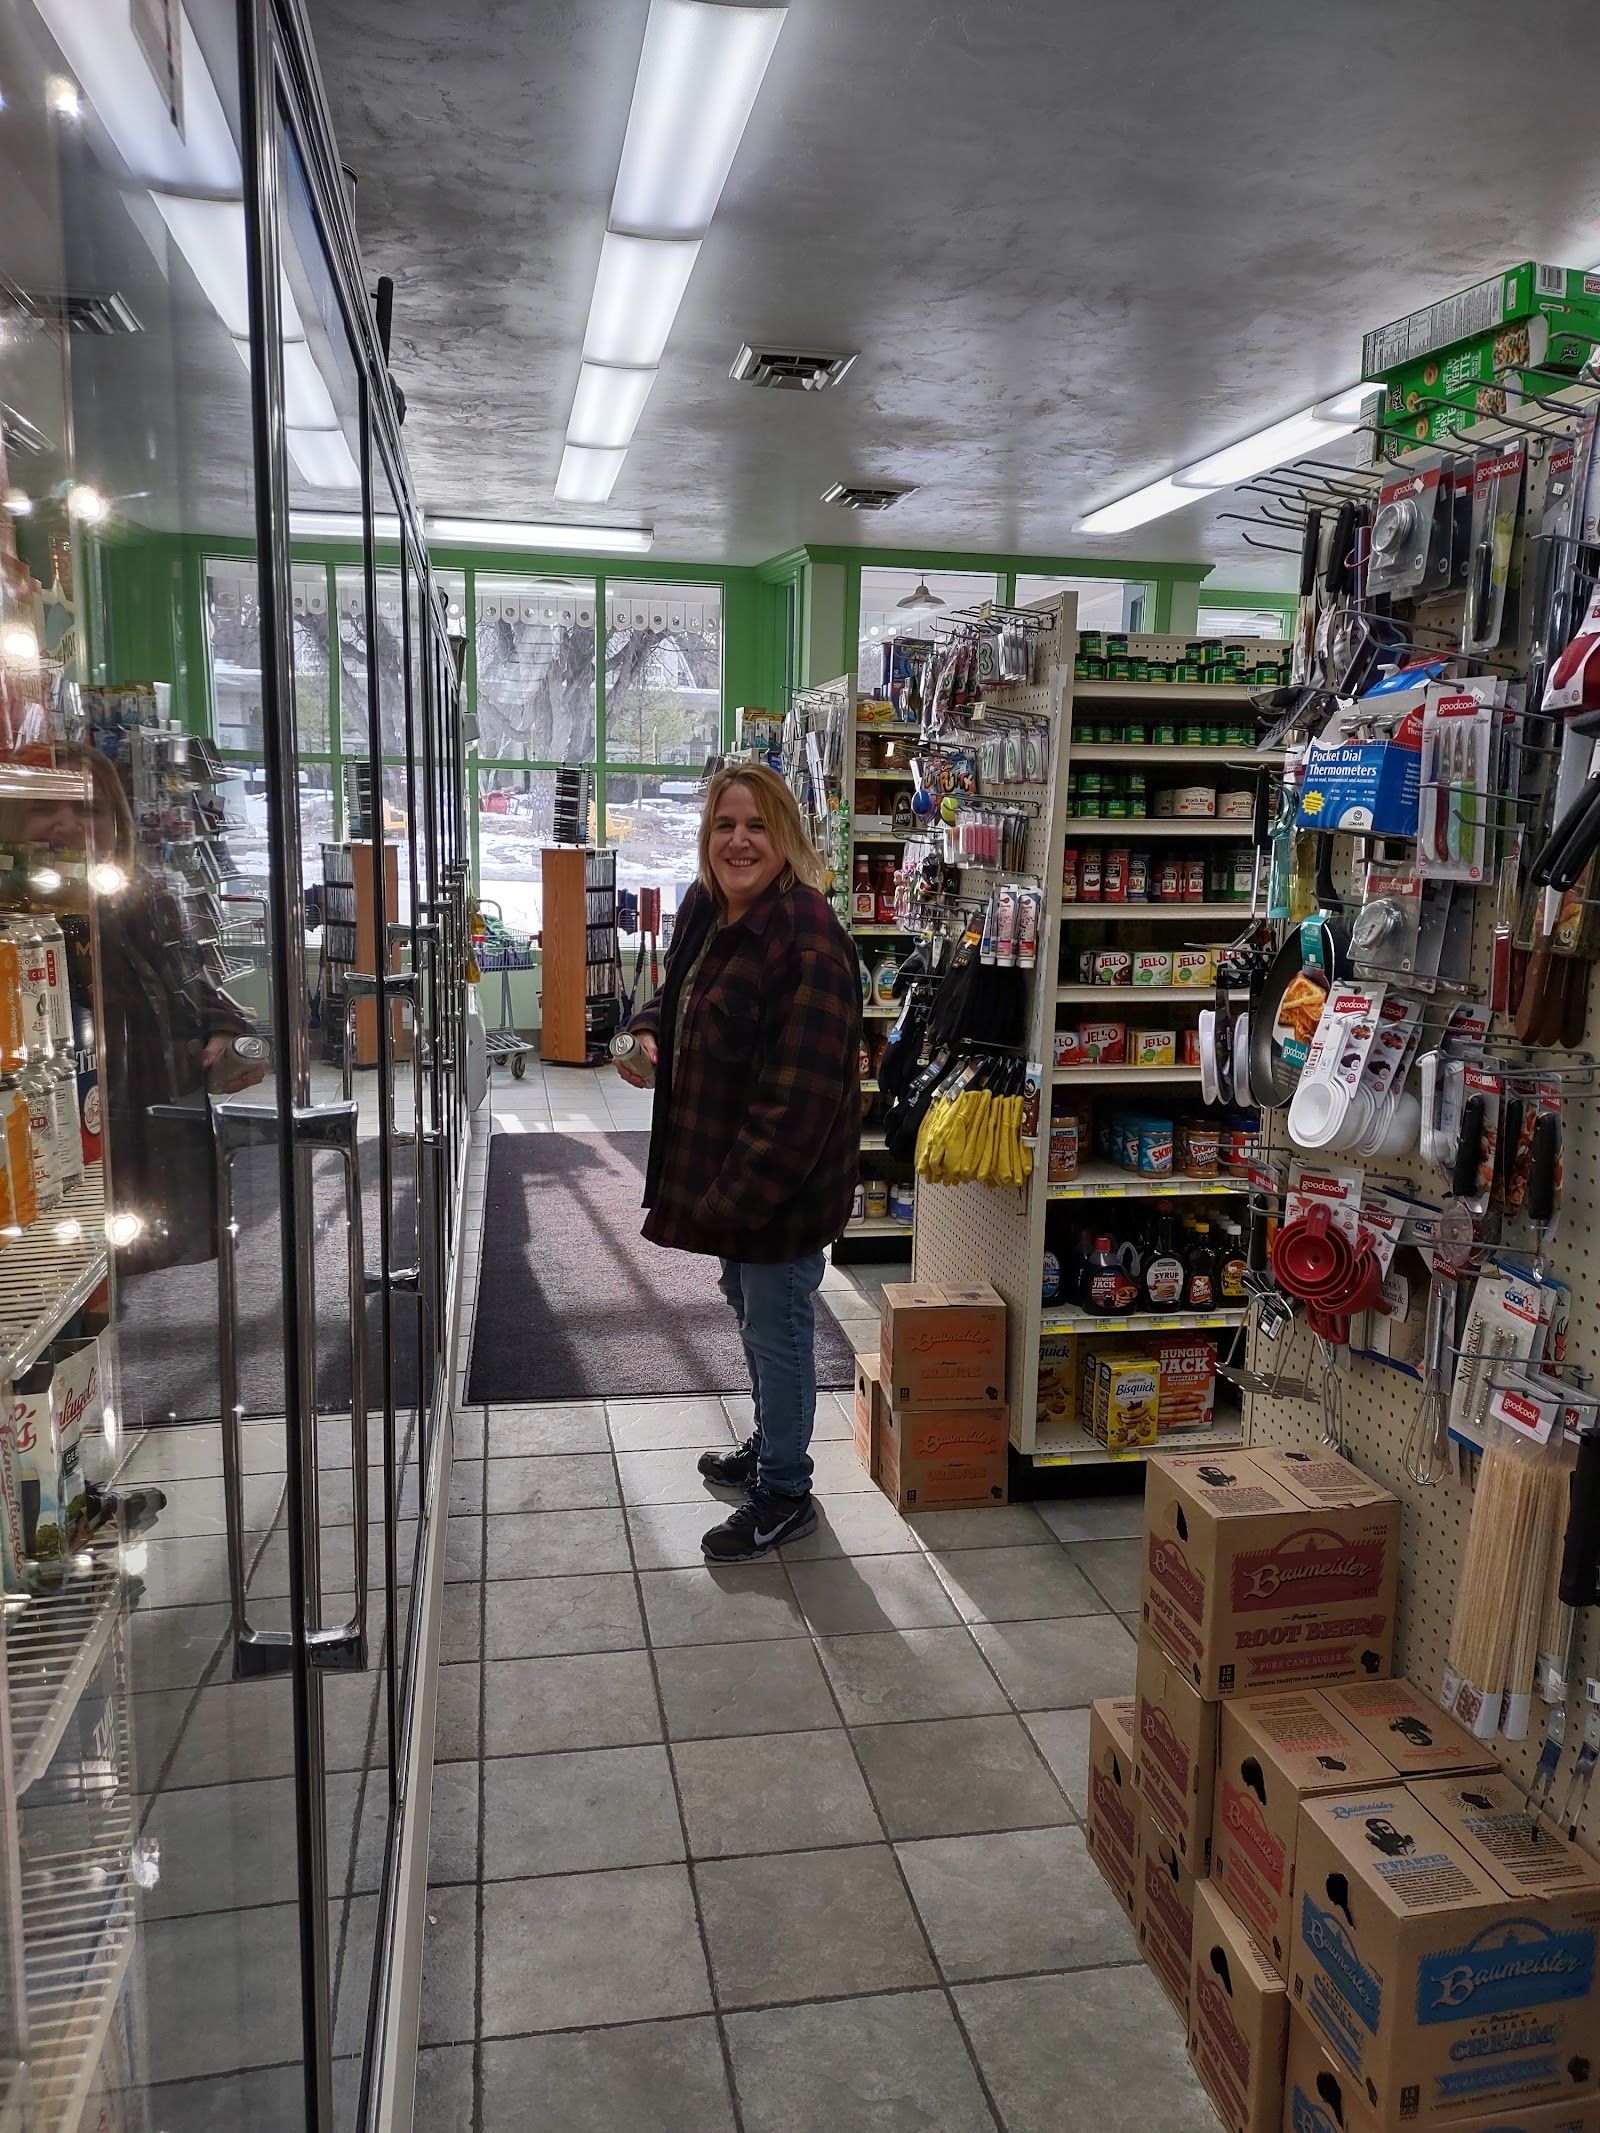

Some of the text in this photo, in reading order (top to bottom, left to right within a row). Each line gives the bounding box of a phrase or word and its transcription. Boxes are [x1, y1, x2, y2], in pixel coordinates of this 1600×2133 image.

[1312, 748, 1362, 762] Pocket Dial
[1309, 764, 1377, 776] Thermometers
[1336, 999, 1370, 1011] goodcook
[1301, 1178, 1345, 1194] goodcook
[1154, 1272, 1180, 1280] SYRUP
[1039, 1345, 1070, 1362] quick
[1160, 1347, 1209, 1359] HUNGRY
[1160, 1357, 1210, 1374] JACK
[1116, 1382, 1156, 1396] Bisquick
[1503, 1397, 1538, 1422] goodcook
[1243, 1555, 1373, 1599] Baumeister
[1235, 1617, 1372, 1650] ROOT BEER
[1260, 1660, 1284, 1671] PURE
[1311, 1655, 1344, 1665] SUGAR
[1327, 1801, 1397, 1820] Baumeister
[1431, 1949, 1583, 2009] Baumeister
[1470, 2017, 1539, 2036] VANILLA
